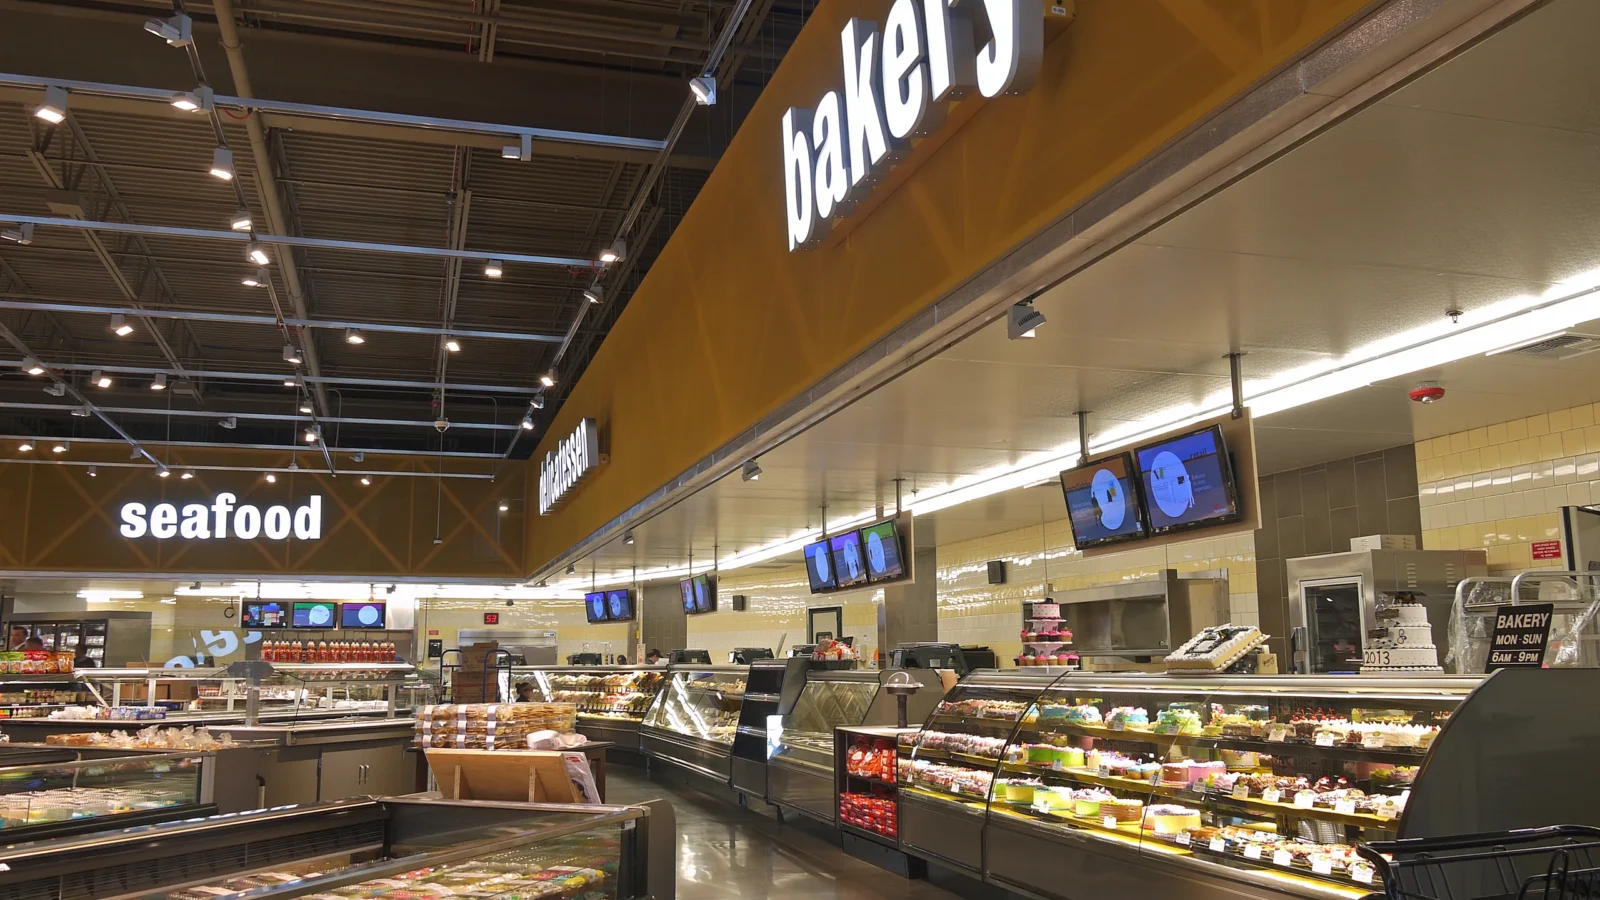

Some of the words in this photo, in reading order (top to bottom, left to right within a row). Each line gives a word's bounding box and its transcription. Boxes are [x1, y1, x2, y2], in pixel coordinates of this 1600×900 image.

[120, 492, 321, 540] seafood
[485, 614, 498, 623] 53
[1496, 612, 1550, 629] BAKERY
[1364, 650, 1391, 665] 2013
